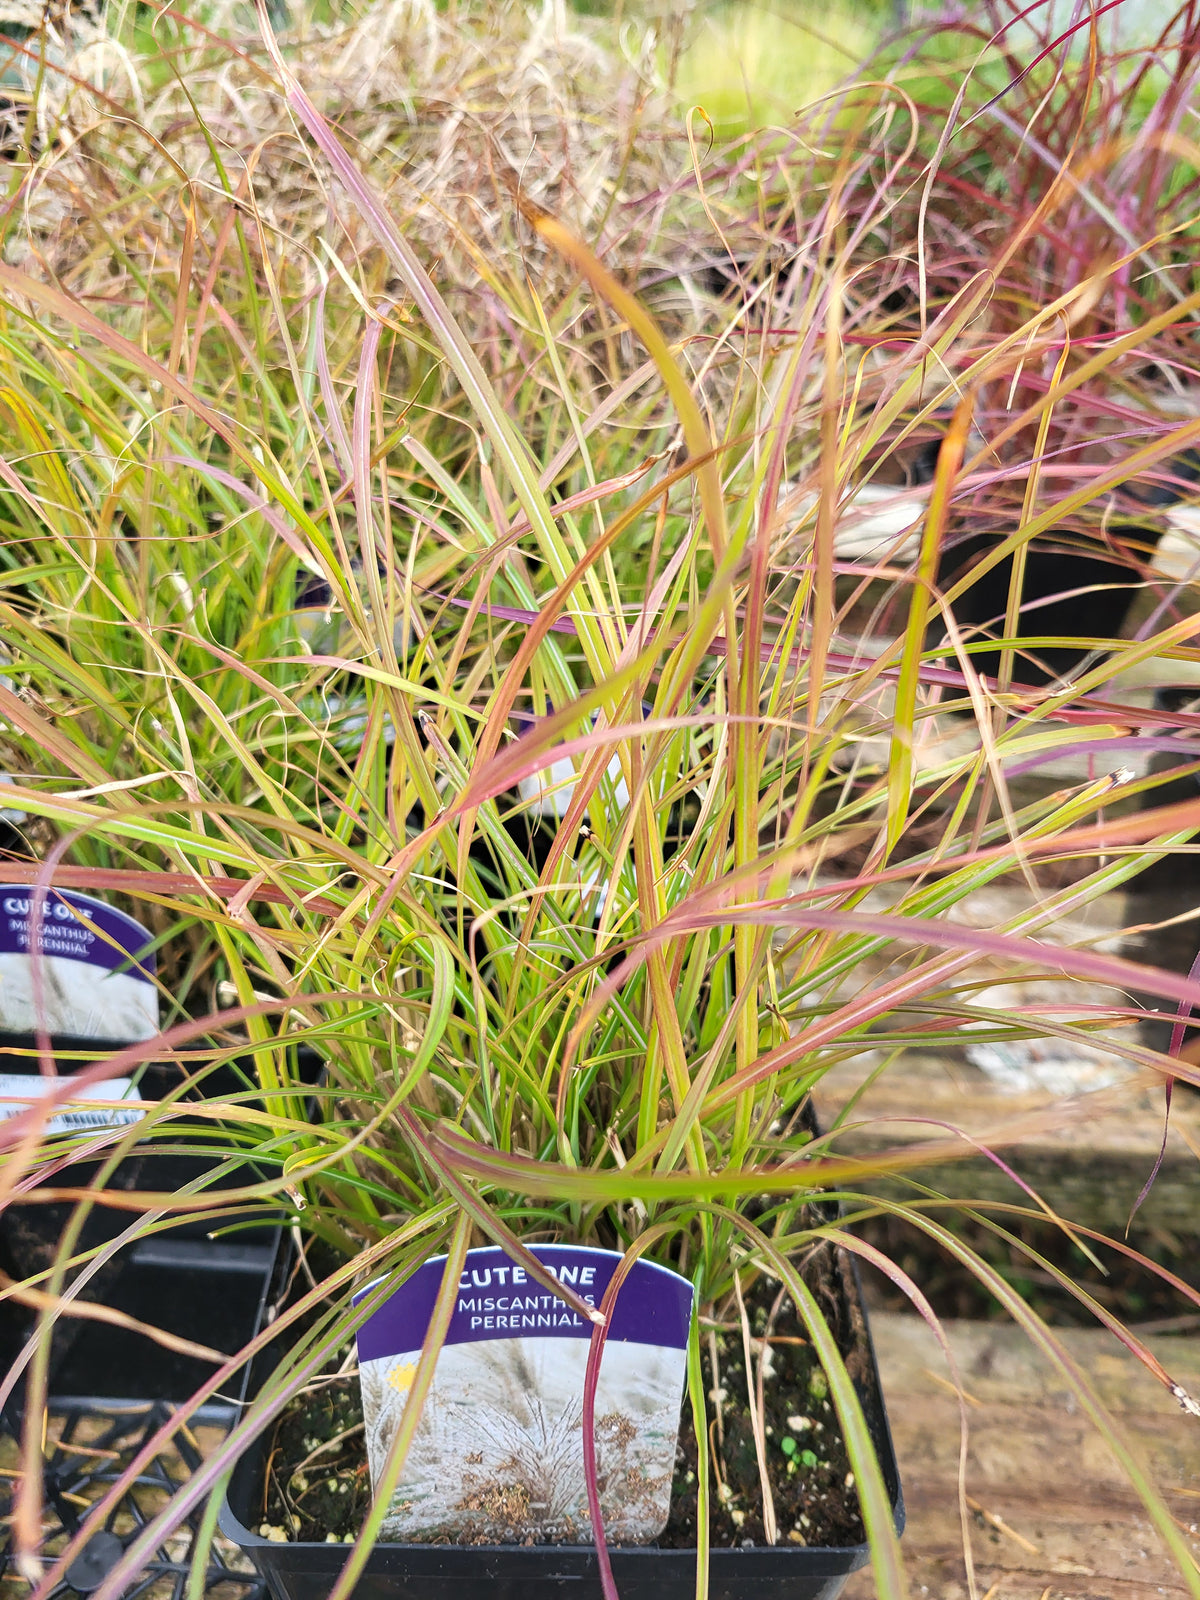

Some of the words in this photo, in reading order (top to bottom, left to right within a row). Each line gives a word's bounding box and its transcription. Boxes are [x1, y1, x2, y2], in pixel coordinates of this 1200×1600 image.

[457, 1266, 528, 1289] CUTE
[458, 1294, 596, 1313] MISCANTHS
[470, 1312, 583, 1330] PERENNIAL
